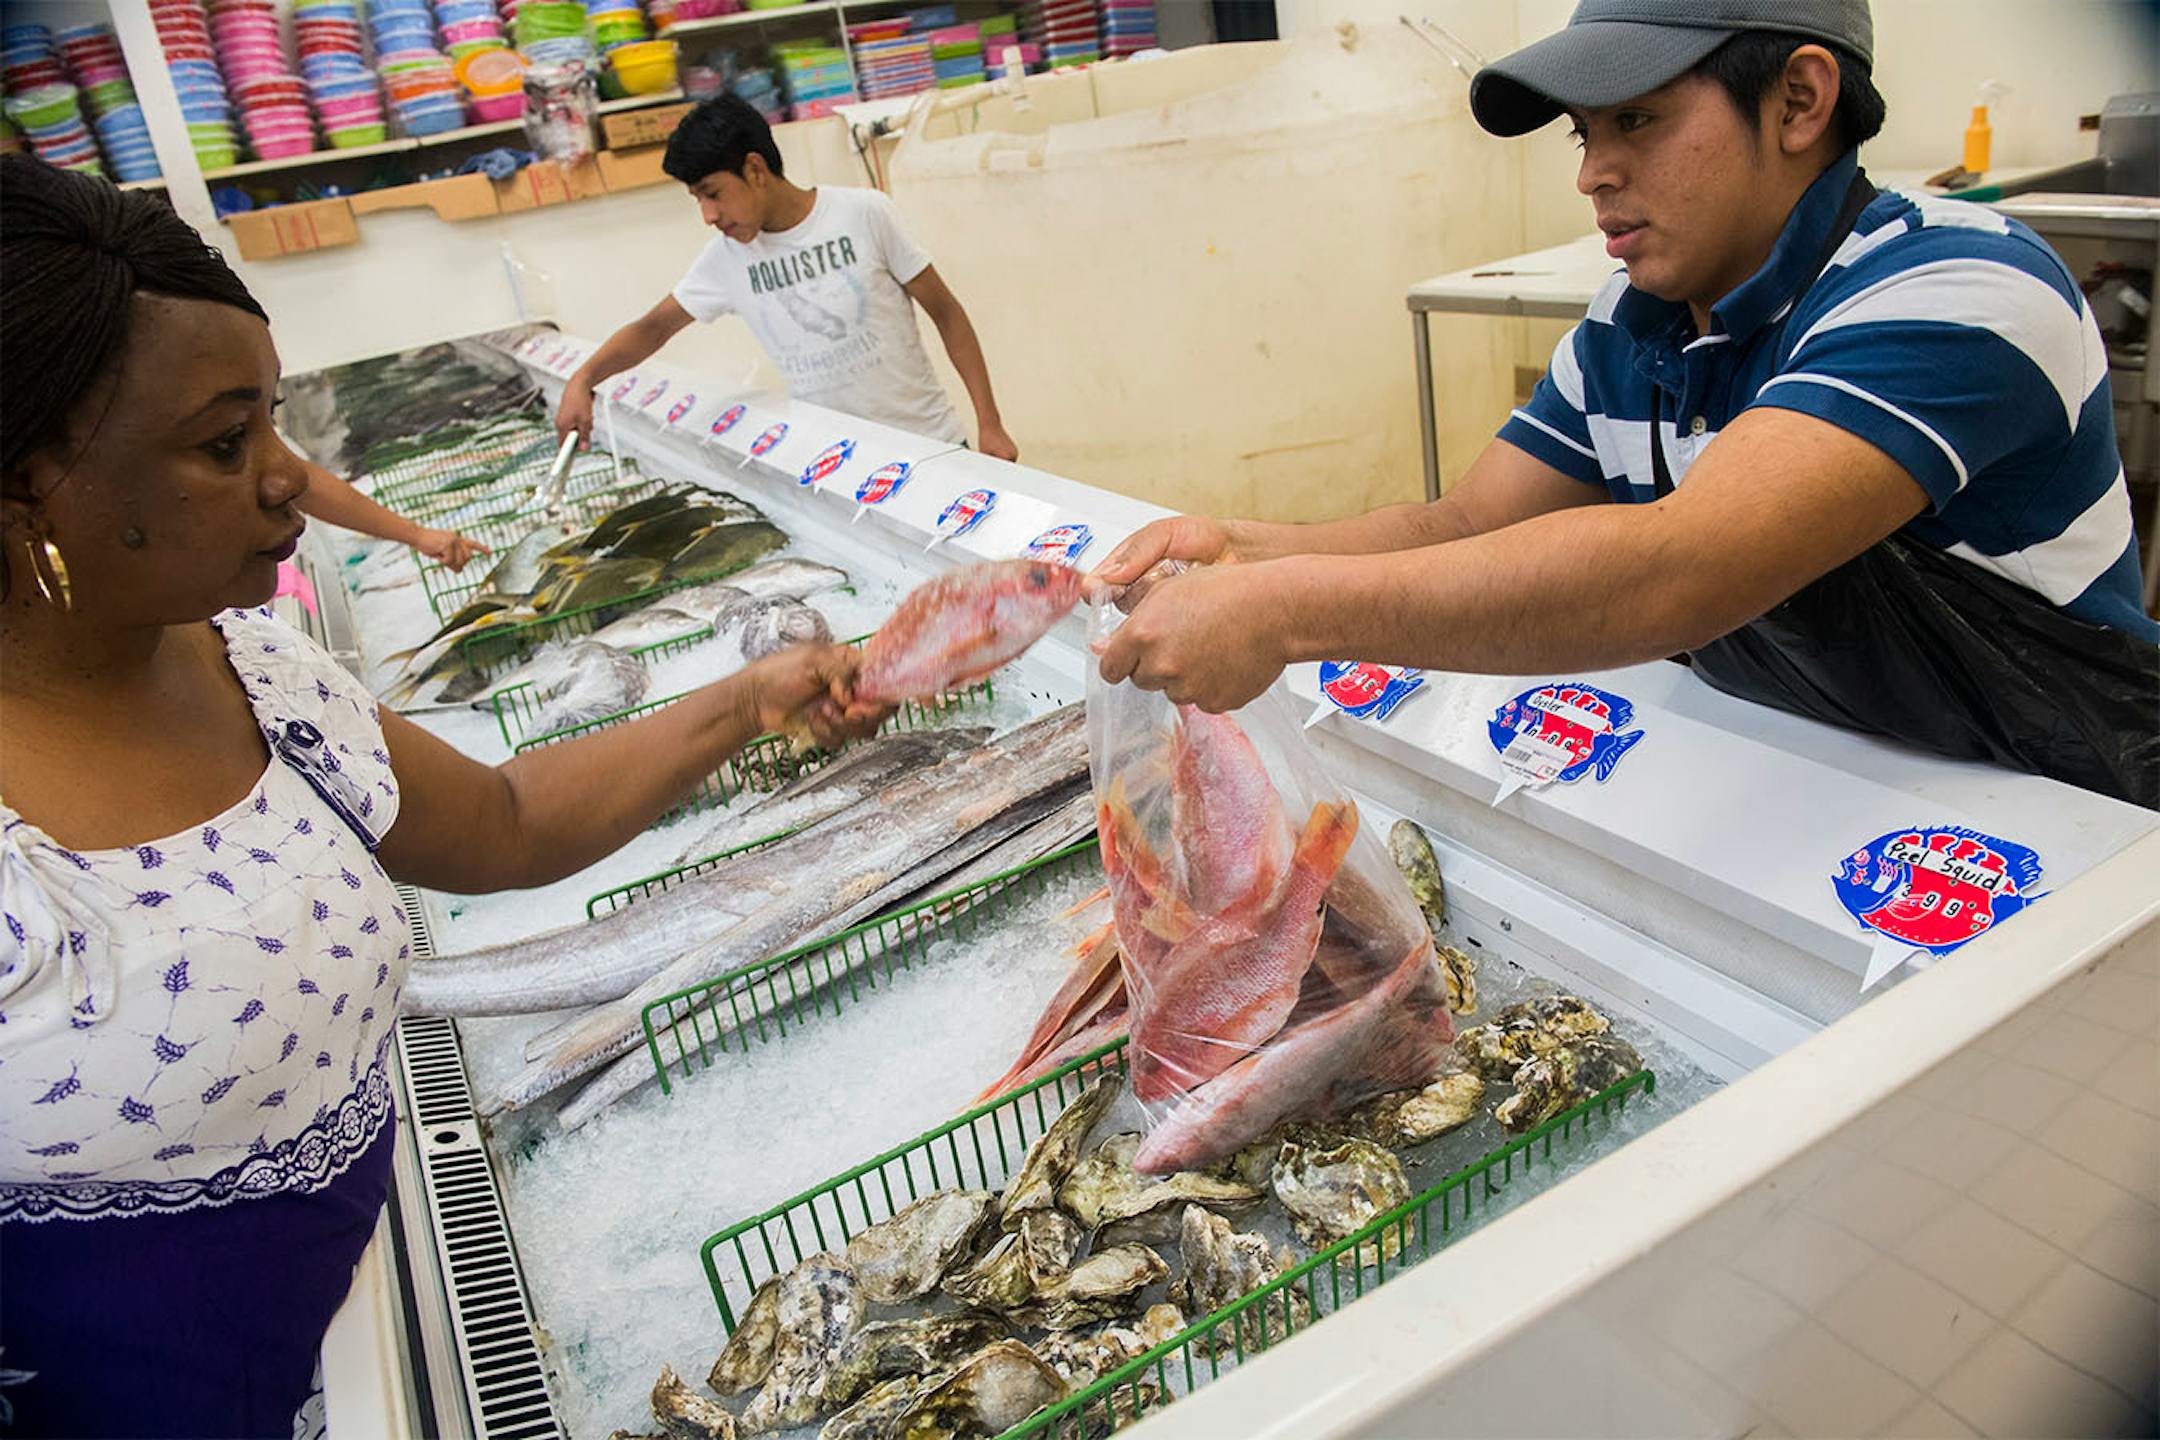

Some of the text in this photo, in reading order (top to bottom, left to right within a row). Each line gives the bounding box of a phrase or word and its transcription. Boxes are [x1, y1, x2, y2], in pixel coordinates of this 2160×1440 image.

[747, 236, 857, 295] HOLLISTER
[1888, 842, 2002, 891] Peel Squid
